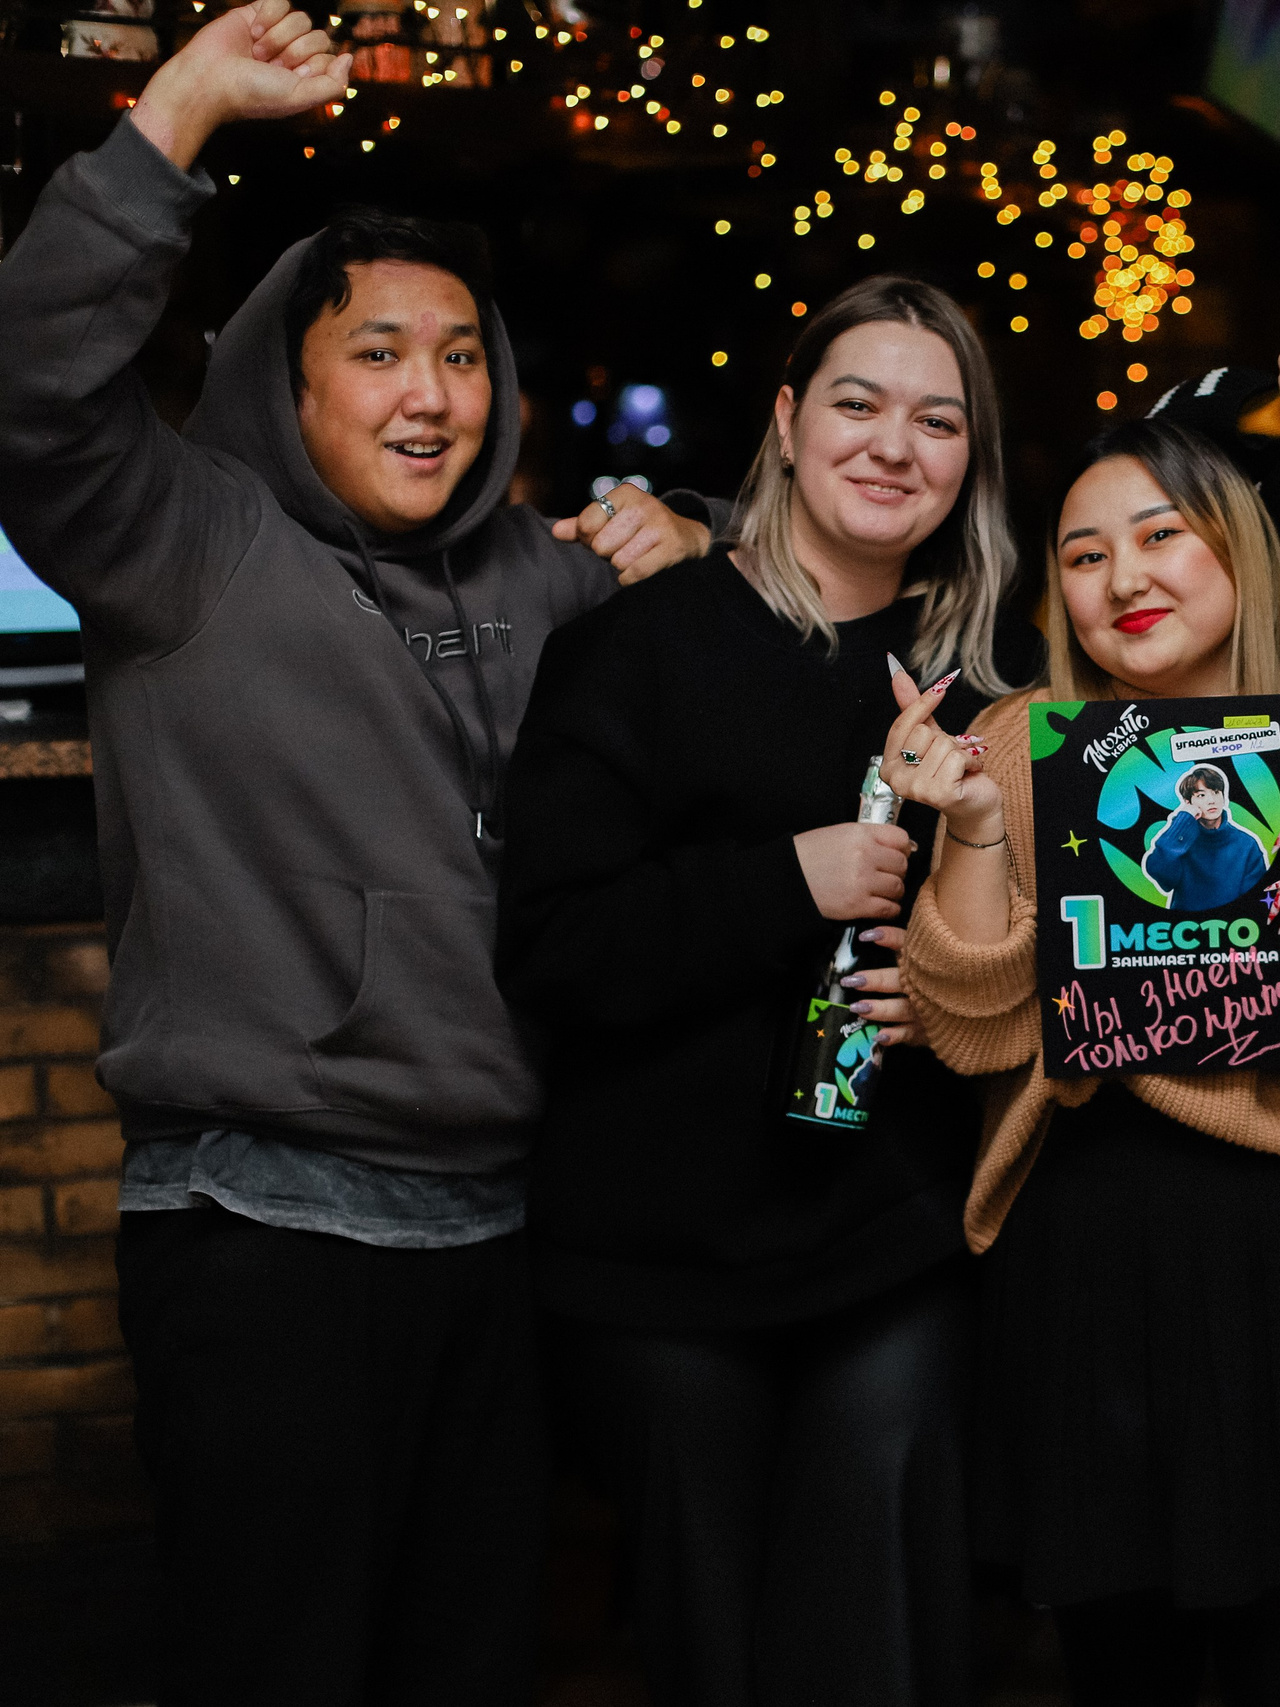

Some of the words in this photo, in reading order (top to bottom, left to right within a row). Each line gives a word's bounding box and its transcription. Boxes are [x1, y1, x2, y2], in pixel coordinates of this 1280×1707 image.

[1111, 733, 1138, 758] КВИЗ
[1175, 735, 1218, 750] УГАДАЙ
[1219, 730, 1277, 744] МЕЛОДИЮ:
[1212, 743, 1243, 754] K-POP
[1060, 895, 1106, 970] 1
[1110, 918, 1260, 952] МЕСТО
[1111, 954, 1196, 968] ЗАНИМАЕТ
[1200, 950, 1279, 965] КОМАНДА
[814, 1081, 838, 1119] 1
